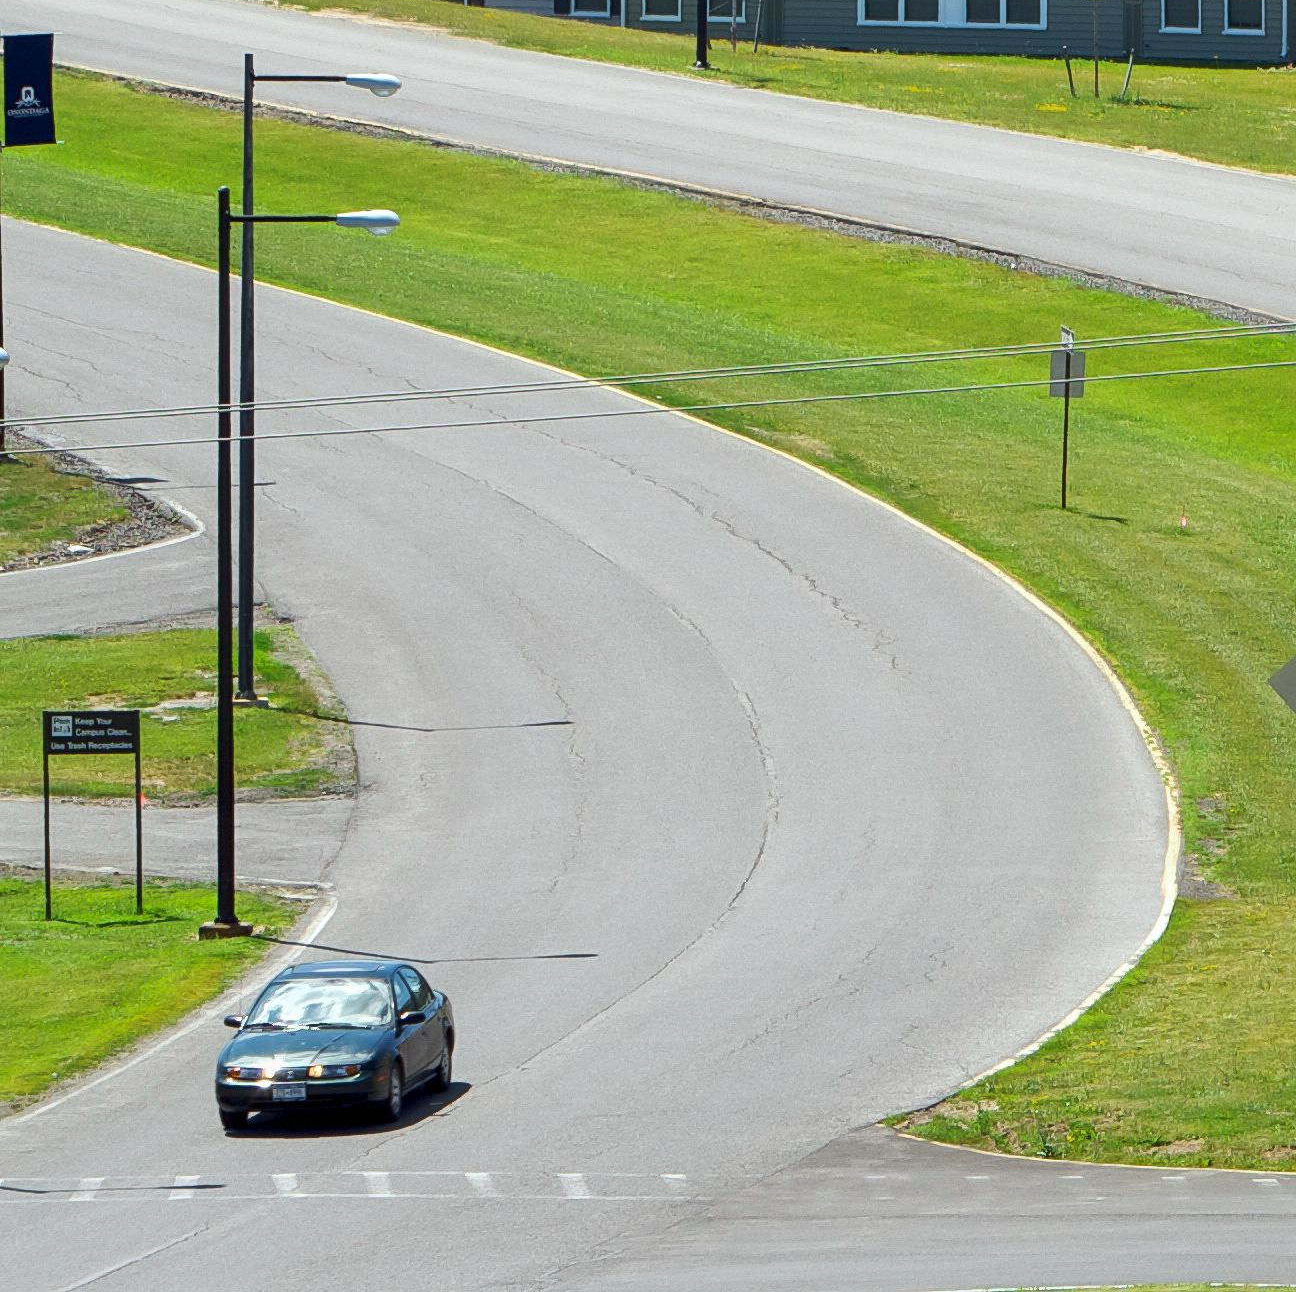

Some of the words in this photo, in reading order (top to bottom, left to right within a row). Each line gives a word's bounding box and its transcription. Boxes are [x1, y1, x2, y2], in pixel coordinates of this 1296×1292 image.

[75, 717, 94, 726] Keep
[96, 717, 112, 725] Your
[76, 728, 105, 737] Campus
[51, 742, 65, 750] Use
[67, 742, 86, 750] Trash
[88, 742, 133, 750] Receptacles
